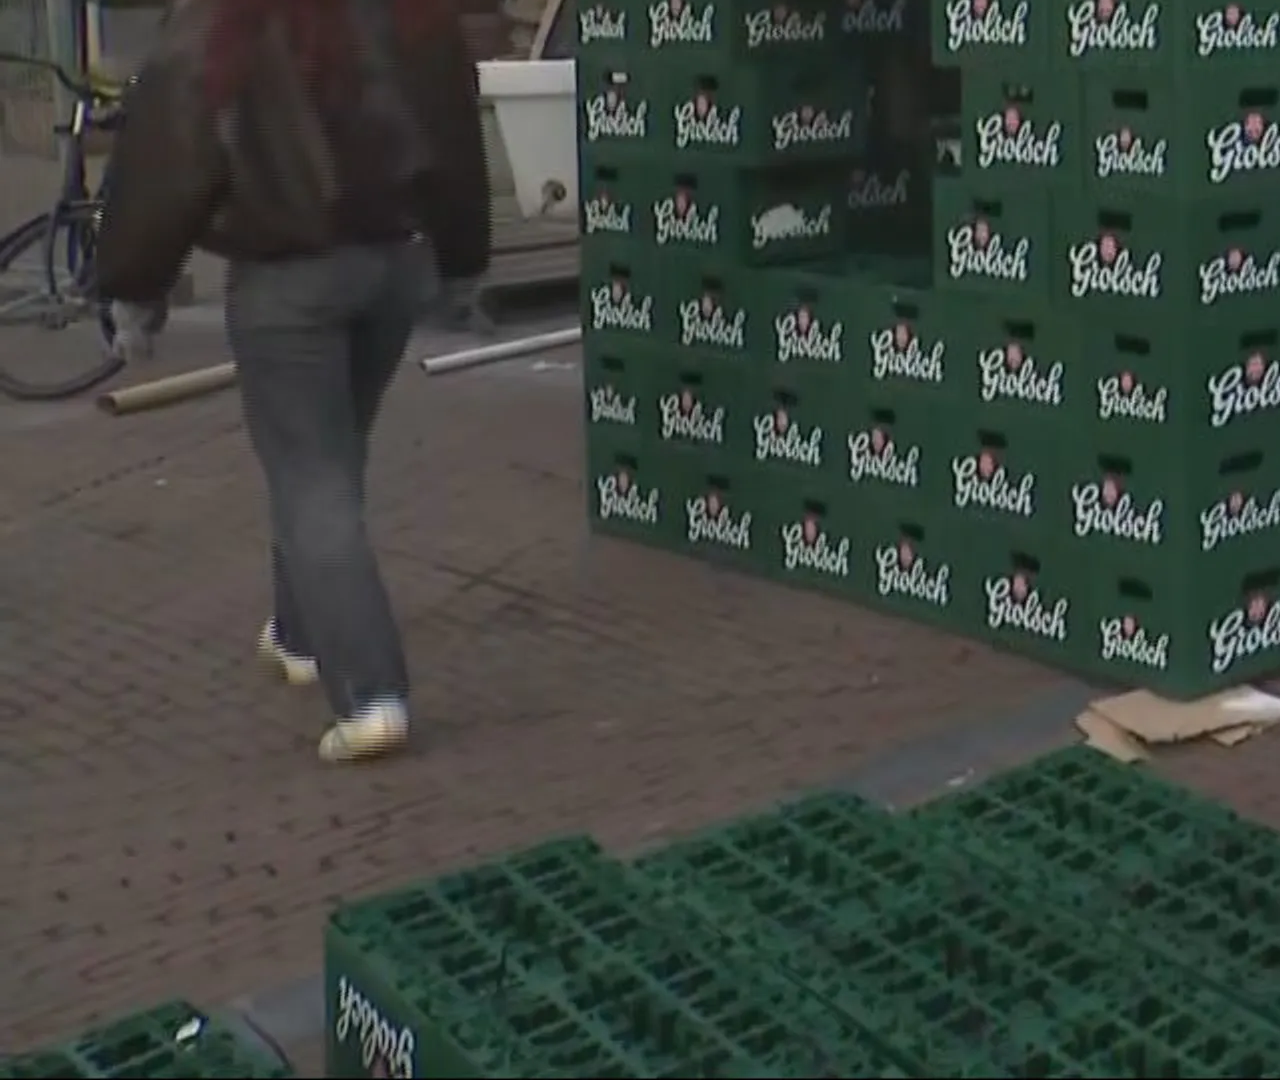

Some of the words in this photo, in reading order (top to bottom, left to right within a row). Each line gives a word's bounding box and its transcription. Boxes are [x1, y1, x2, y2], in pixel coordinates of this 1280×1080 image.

[746, 11, 822, 46] Grolsch
[1068, 0, 1158, 56] Grolsch
[1197, 5, 1279, 56] Grolsch
[675, 96, 739, 147] Grolsch
[773, 108, 851, 149] Grolsch
[977, 109, 1060, 168] Grolsch
[1096, 129, 1166, 177] Grolsch
[655, 199, 718, 243] Grolsch
[948, 222, 1028, 280] Grolsch
[1070, 242, 1161, 297] Grolsch
[1200, 249, 1280, 303] Grolsch
[680, 296, 744, 346] Grolsch
[776, 309, 841, 362] Grolsch
[871, 325, 943, 382] Grolsch
[980, 344, 1062, 404] Grolsch
[660, 392, 723, 442] Grolsch
[1098, 372, 1166, 422] Grolsch
[754, 410, 821, 465] Grolsch
[848, 429, 918, 486] Grolsch
[598, 473, 658, 522] Grolsch
[953, 456, 1033, 516] Grolsch
[1072, 480, 1162, 543] Grolsch
[687, 496, 751, 548] Grolsch
[782, 524, 849, 575] Grolsch
[876, 544, 948, 605] Grolsch
[986, 574, 1067, 640] Grolsch
[1101, 616, 1168, 669] Grolsch
